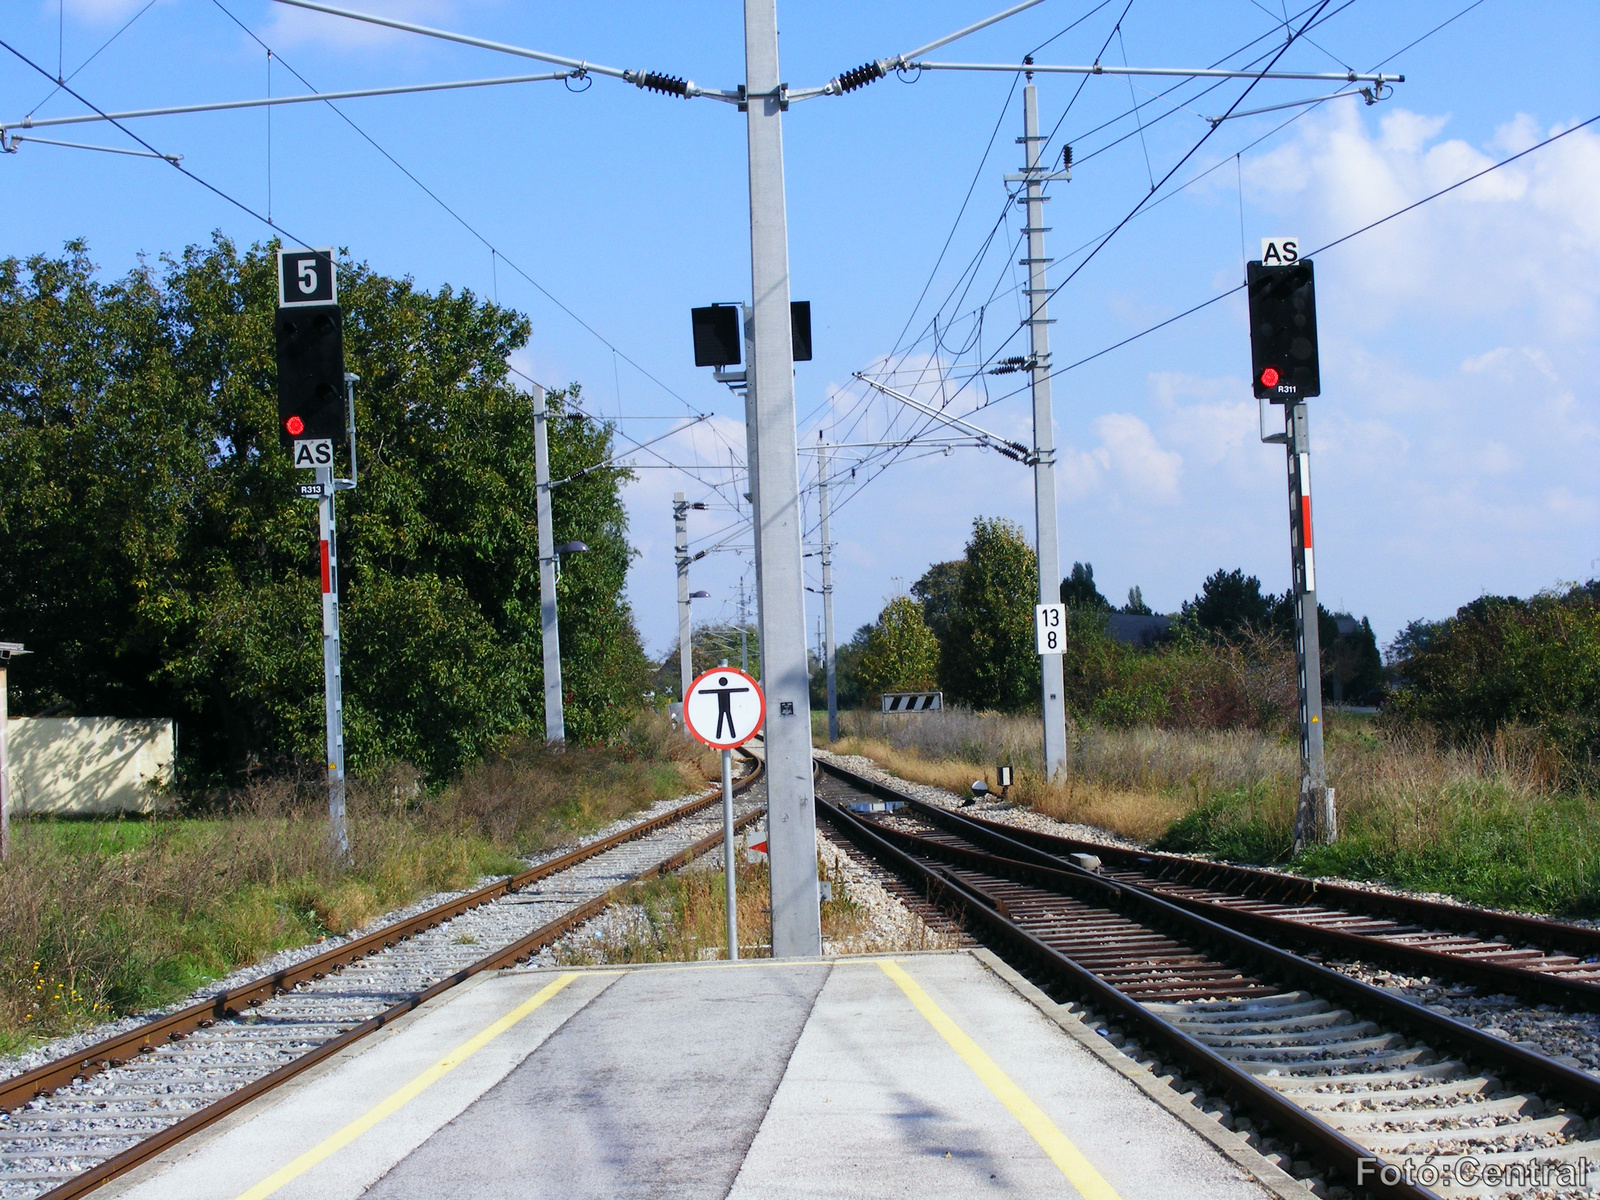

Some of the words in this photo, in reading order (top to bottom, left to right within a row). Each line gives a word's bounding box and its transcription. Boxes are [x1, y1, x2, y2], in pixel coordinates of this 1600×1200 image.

[1264, 242, 1298, 262] AS
[298, 260, 318, 294] 5
[296, 443, 331, 465] AS
[1042, 609, 1059, 627] 13
[1048, 631, 1057, 649] 8
